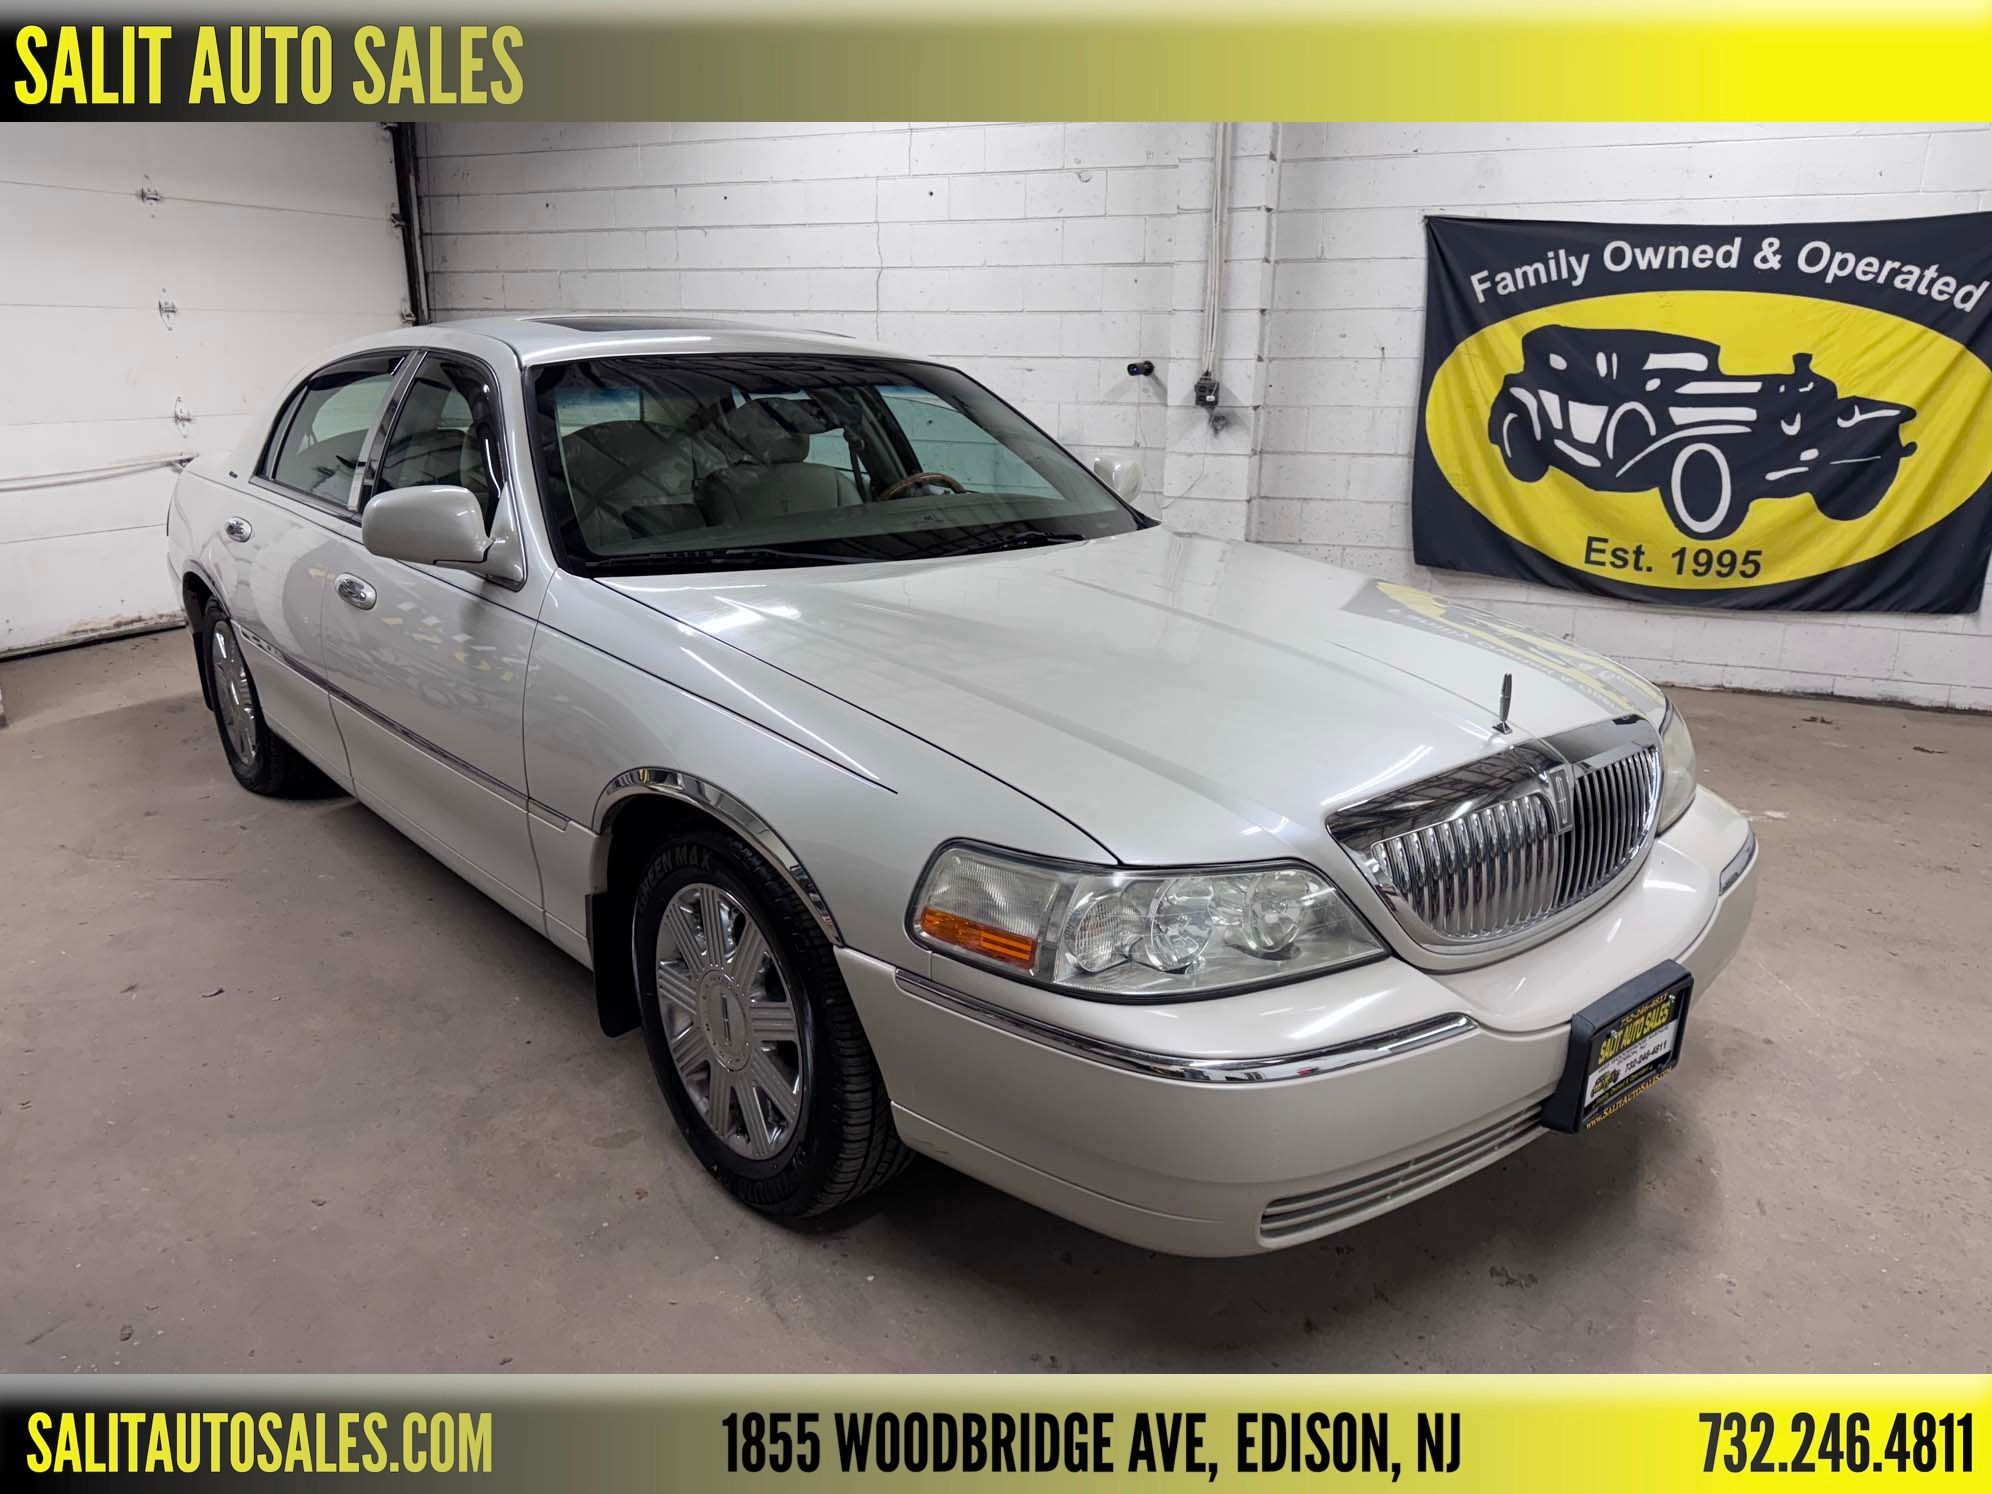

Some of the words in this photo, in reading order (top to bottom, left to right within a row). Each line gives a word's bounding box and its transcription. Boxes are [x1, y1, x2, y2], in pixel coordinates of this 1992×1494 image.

[1471, 249, 1590, 303] Family
[1603, 238, 1742, 272] Owned
[1753, 238, 1782, 270] &
[1797, 240, 1990, 313] Operated
[1584, 536, 1654, 573] Est.
[1670, 547, 1763, 578] 1995
[1620, 1014, 1646, 1050] AUTO
[1643, 1001, 1671, 1035] SALES
